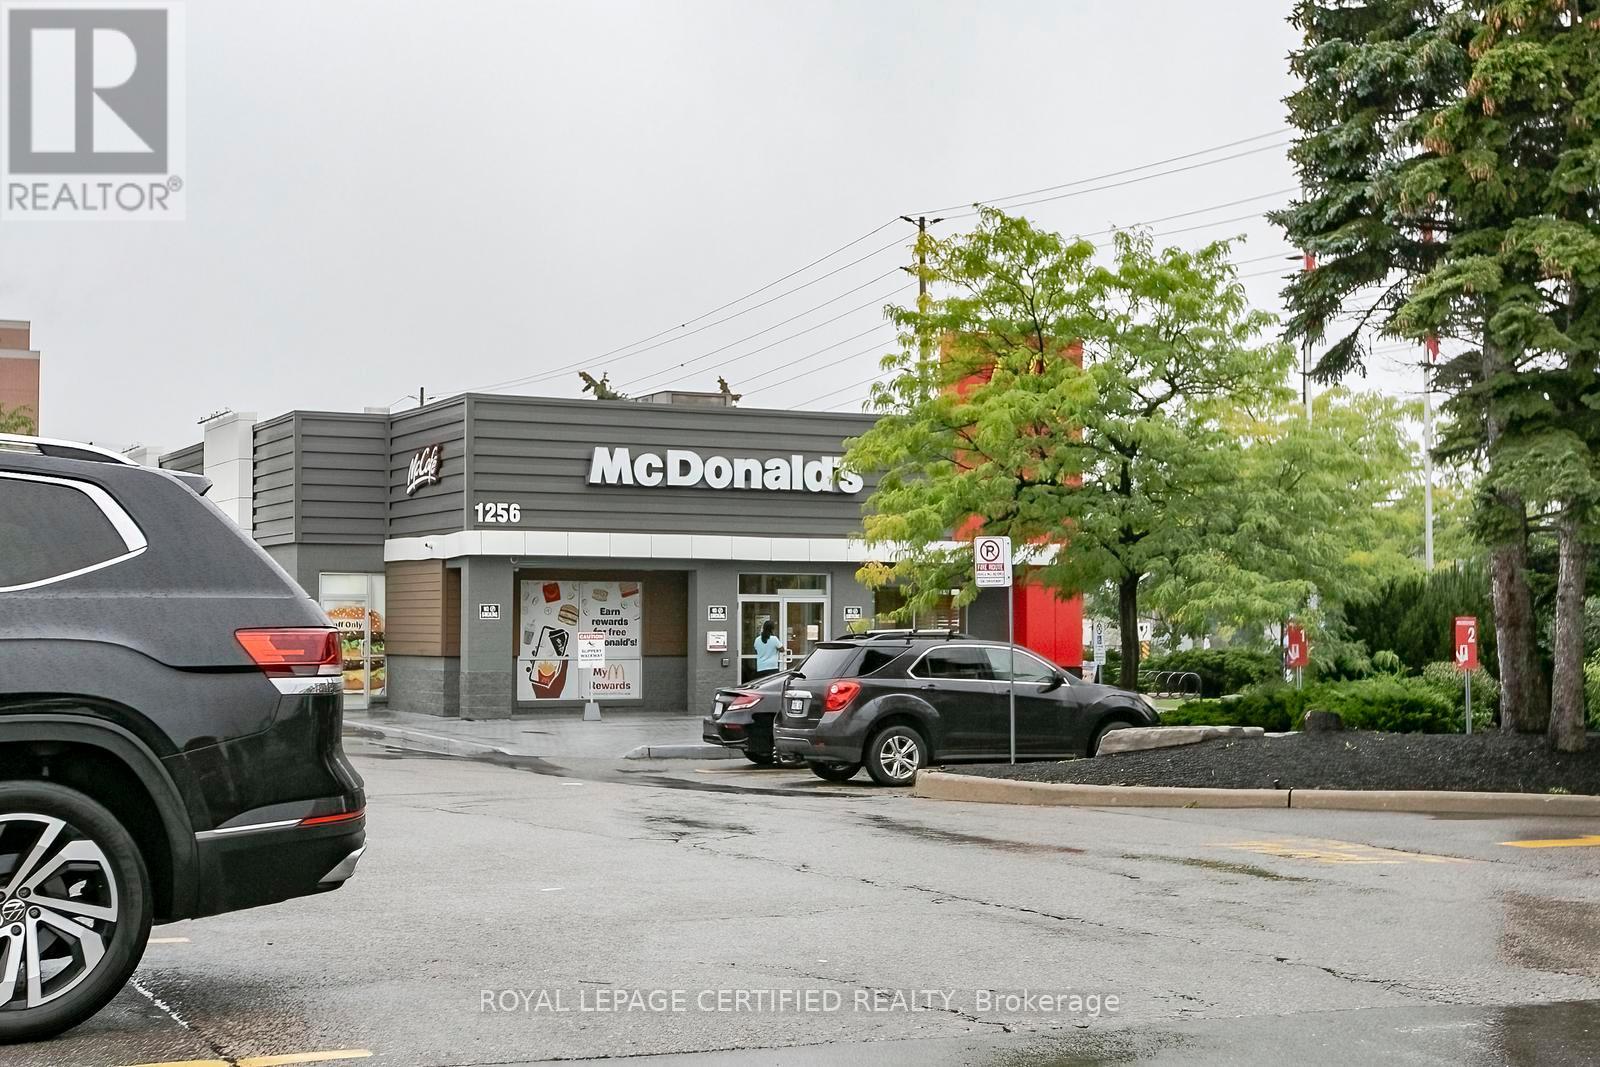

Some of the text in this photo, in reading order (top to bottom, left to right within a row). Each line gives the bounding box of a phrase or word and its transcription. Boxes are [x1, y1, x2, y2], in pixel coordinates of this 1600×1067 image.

[589, 447, 864, 493] McDonald's
[474, 502, 521, 523] 1256
[600, 607, 620, 616] Earn
[345, 621, 363, 629] Only
[592, 618, 628, 626] rewards
[609, 627, 627, 636] free
[1300, 630, 1305, 642] 1
[1467, 626, 1475, 643] 2
[604, 638, 638, 647] onald's!
[593, 668, 607, 678] My
